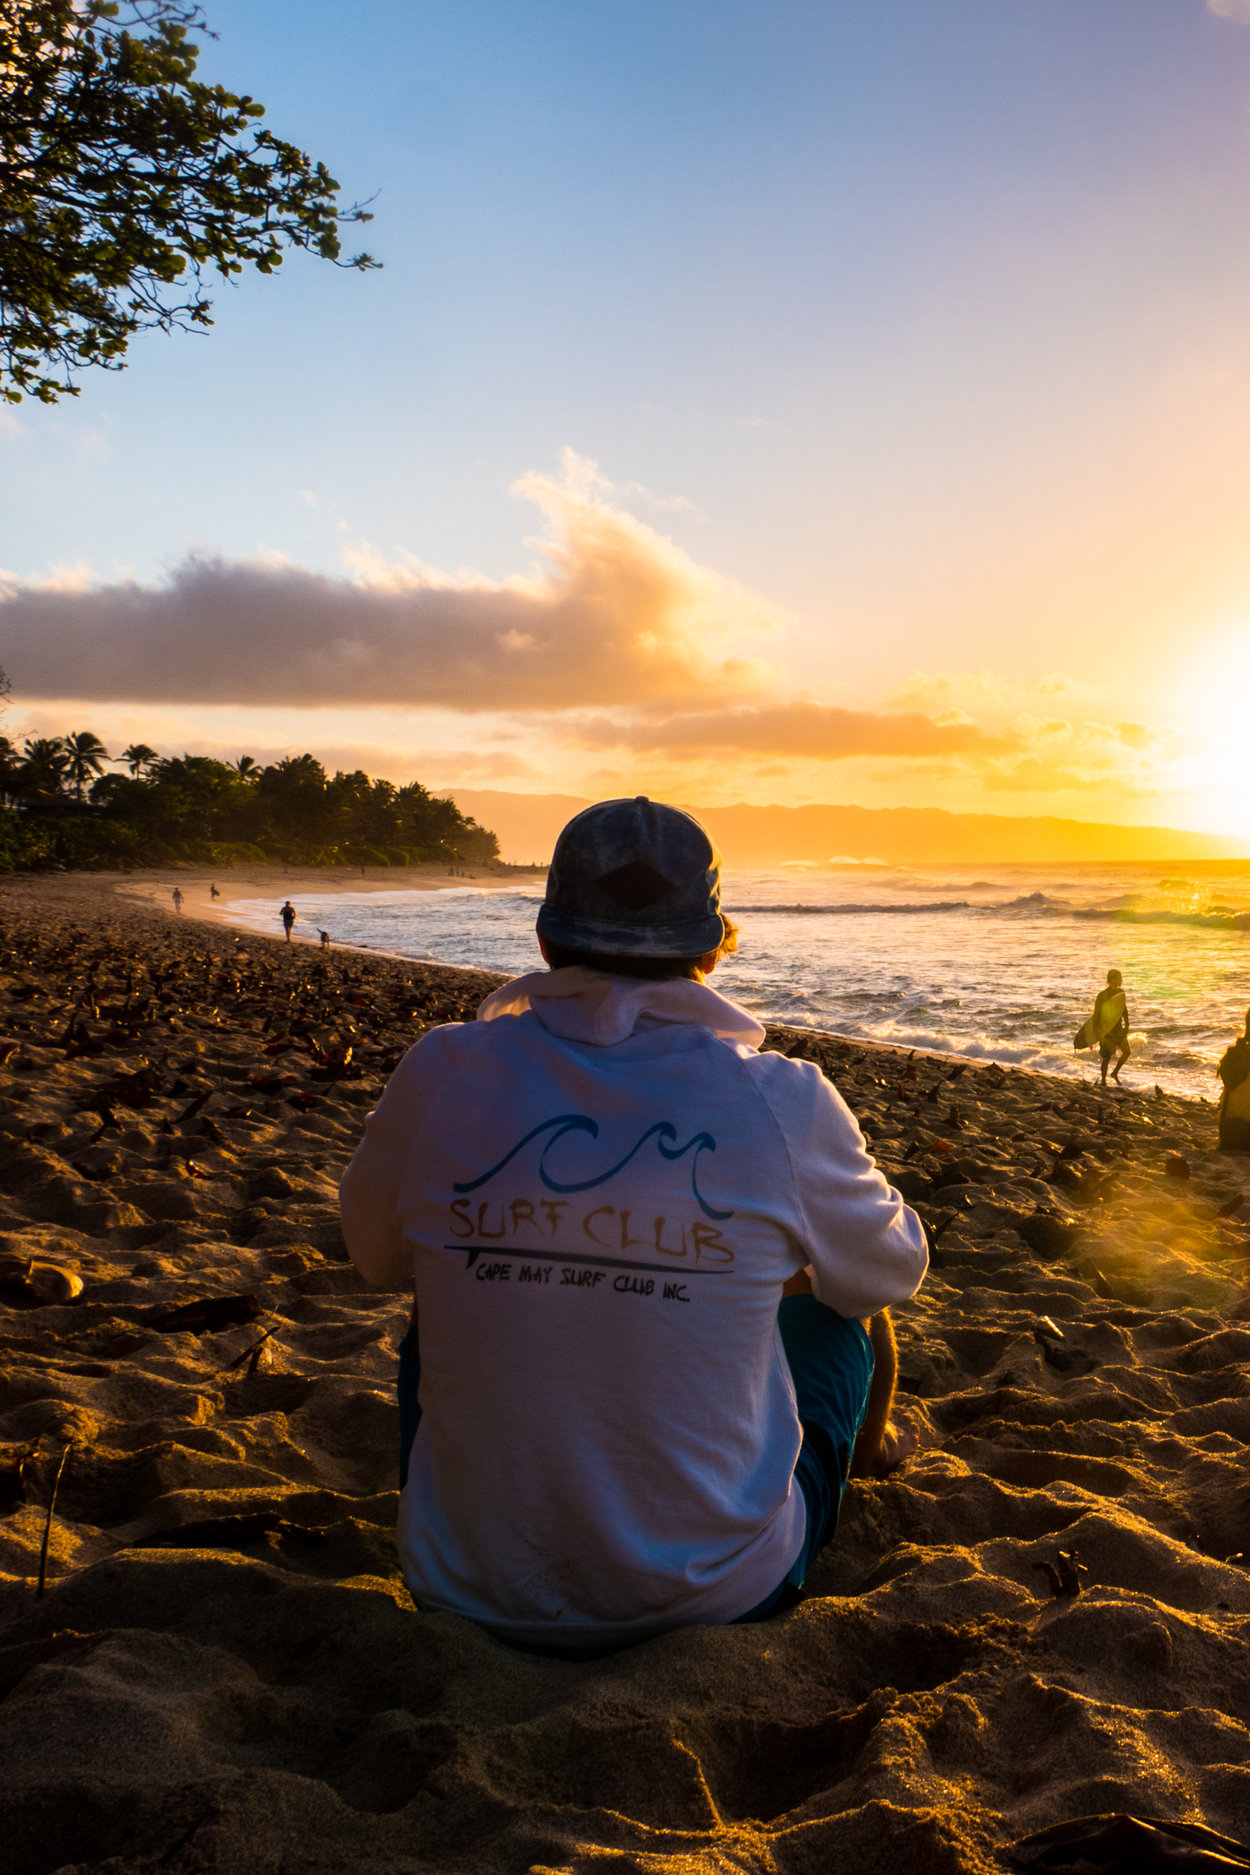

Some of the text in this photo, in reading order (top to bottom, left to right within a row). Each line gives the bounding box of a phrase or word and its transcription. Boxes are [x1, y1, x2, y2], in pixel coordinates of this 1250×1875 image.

[449, 1198, 735, 1263] SURF CLUB
[476, 1263, 512, 1281] CAPE
[518, 1265, 552, 1284] MAY
[559, 1268, 606, 1289] SURF
[613, 1275, 655, 1295] CLUB
